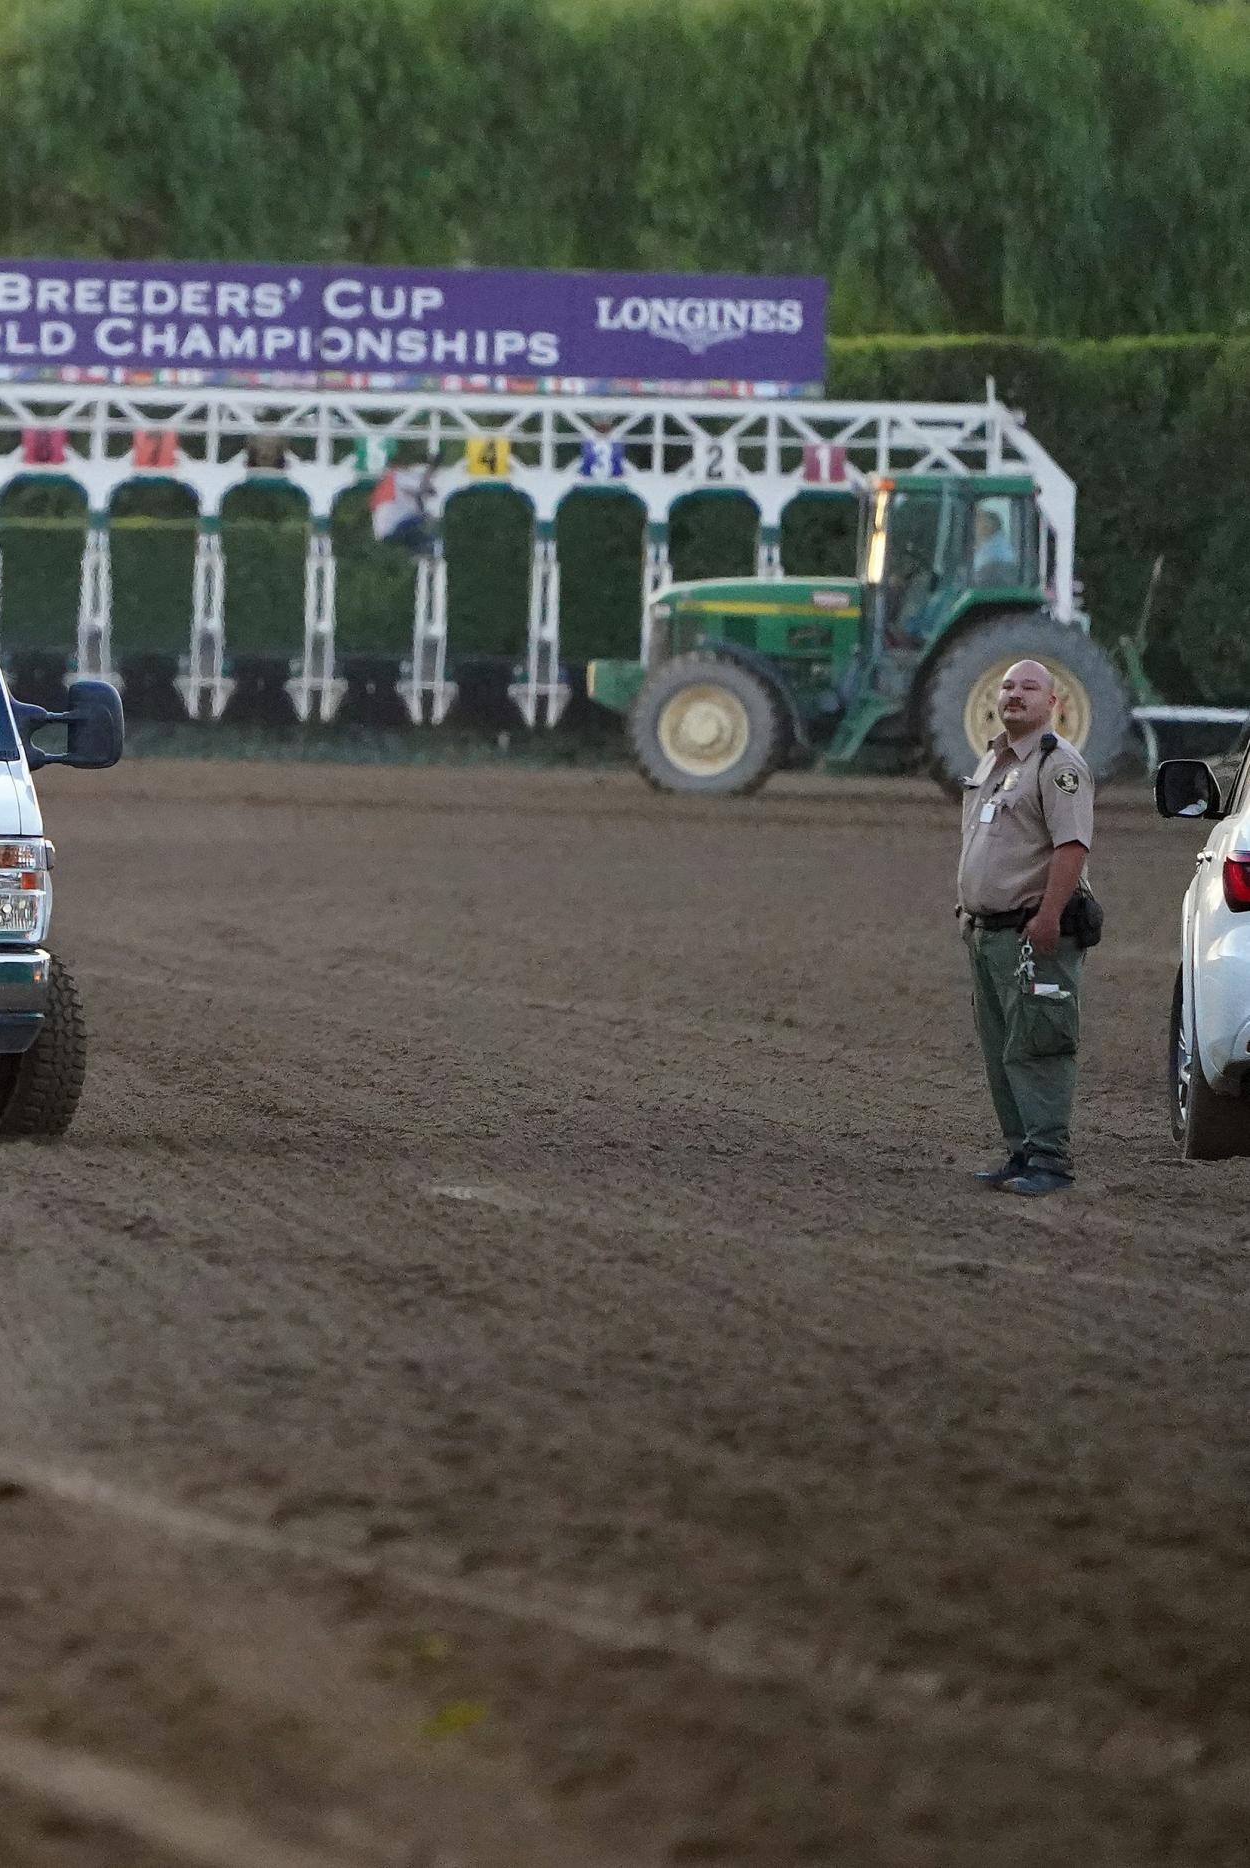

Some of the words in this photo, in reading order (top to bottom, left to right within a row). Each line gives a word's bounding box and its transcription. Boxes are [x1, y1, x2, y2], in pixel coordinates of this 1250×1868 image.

[322, 278, 445, 321] CUP
[596, 297, 804, 335] LONGINES
[94, 318, 560, 367] CHAMPIONSHIPS
[478, 439, 499, 475] 4
[704, 444, 725, 480] 2
[816, 445, 831, 482] 1
